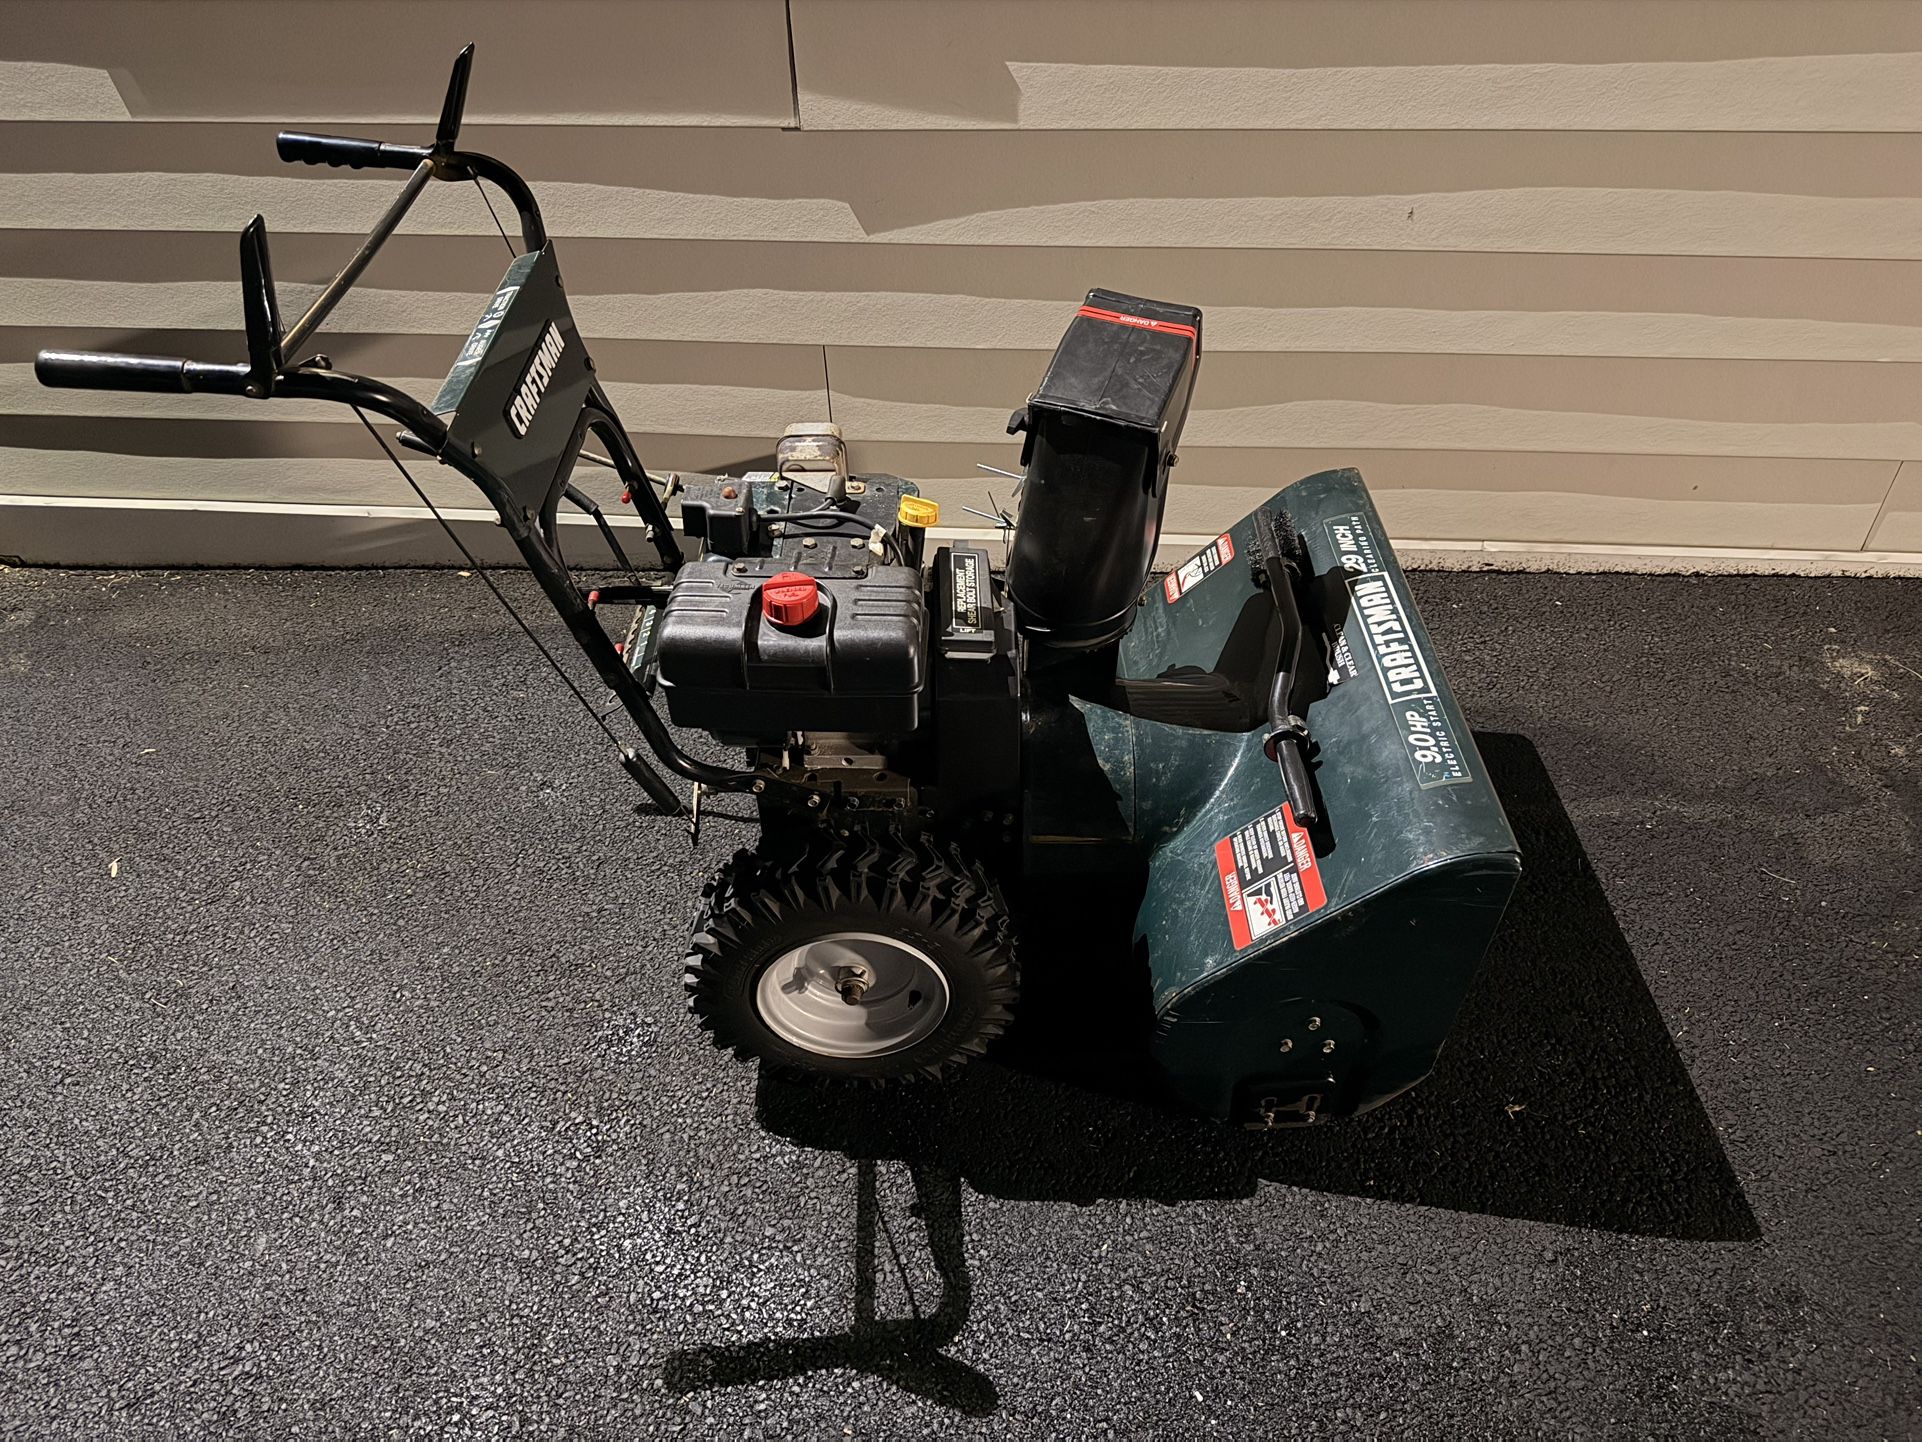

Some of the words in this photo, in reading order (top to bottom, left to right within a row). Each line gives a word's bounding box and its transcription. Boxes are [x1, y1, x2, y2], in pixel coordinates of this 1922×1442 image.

[1120, 315, 1150, 326] DANGER
[510, 321, 565, 435] CRAFTSMAN
[1333, 525, 1358, 552] INCH
[1351, 516, 1364, 534] PATH
[1340, 554, 1368, 572] 29
[1359, 537, 1379, 572] CLEARING
[965, 558, 975, 587] STORAGE
[956, 568, 966, 612] REPLACEMENT
[966, 587, 976, 603] BOLT
[967, 603, 977, 624] SHEAR
[1333, 623, 1346, 646] CLEAN
[1354, 580, 1424, 693] CRAFTSMAN
[1405, 711, 1431, 732] HP
[1424, 699, 1441, 727] START
[1407, 734, 1443, 763] 9.0
[1436, 731, 1462, 777] ELECTRIC
[1294, 839, 1312, 872] DANGER
[1225, 871, 1241, 904] DANGER
